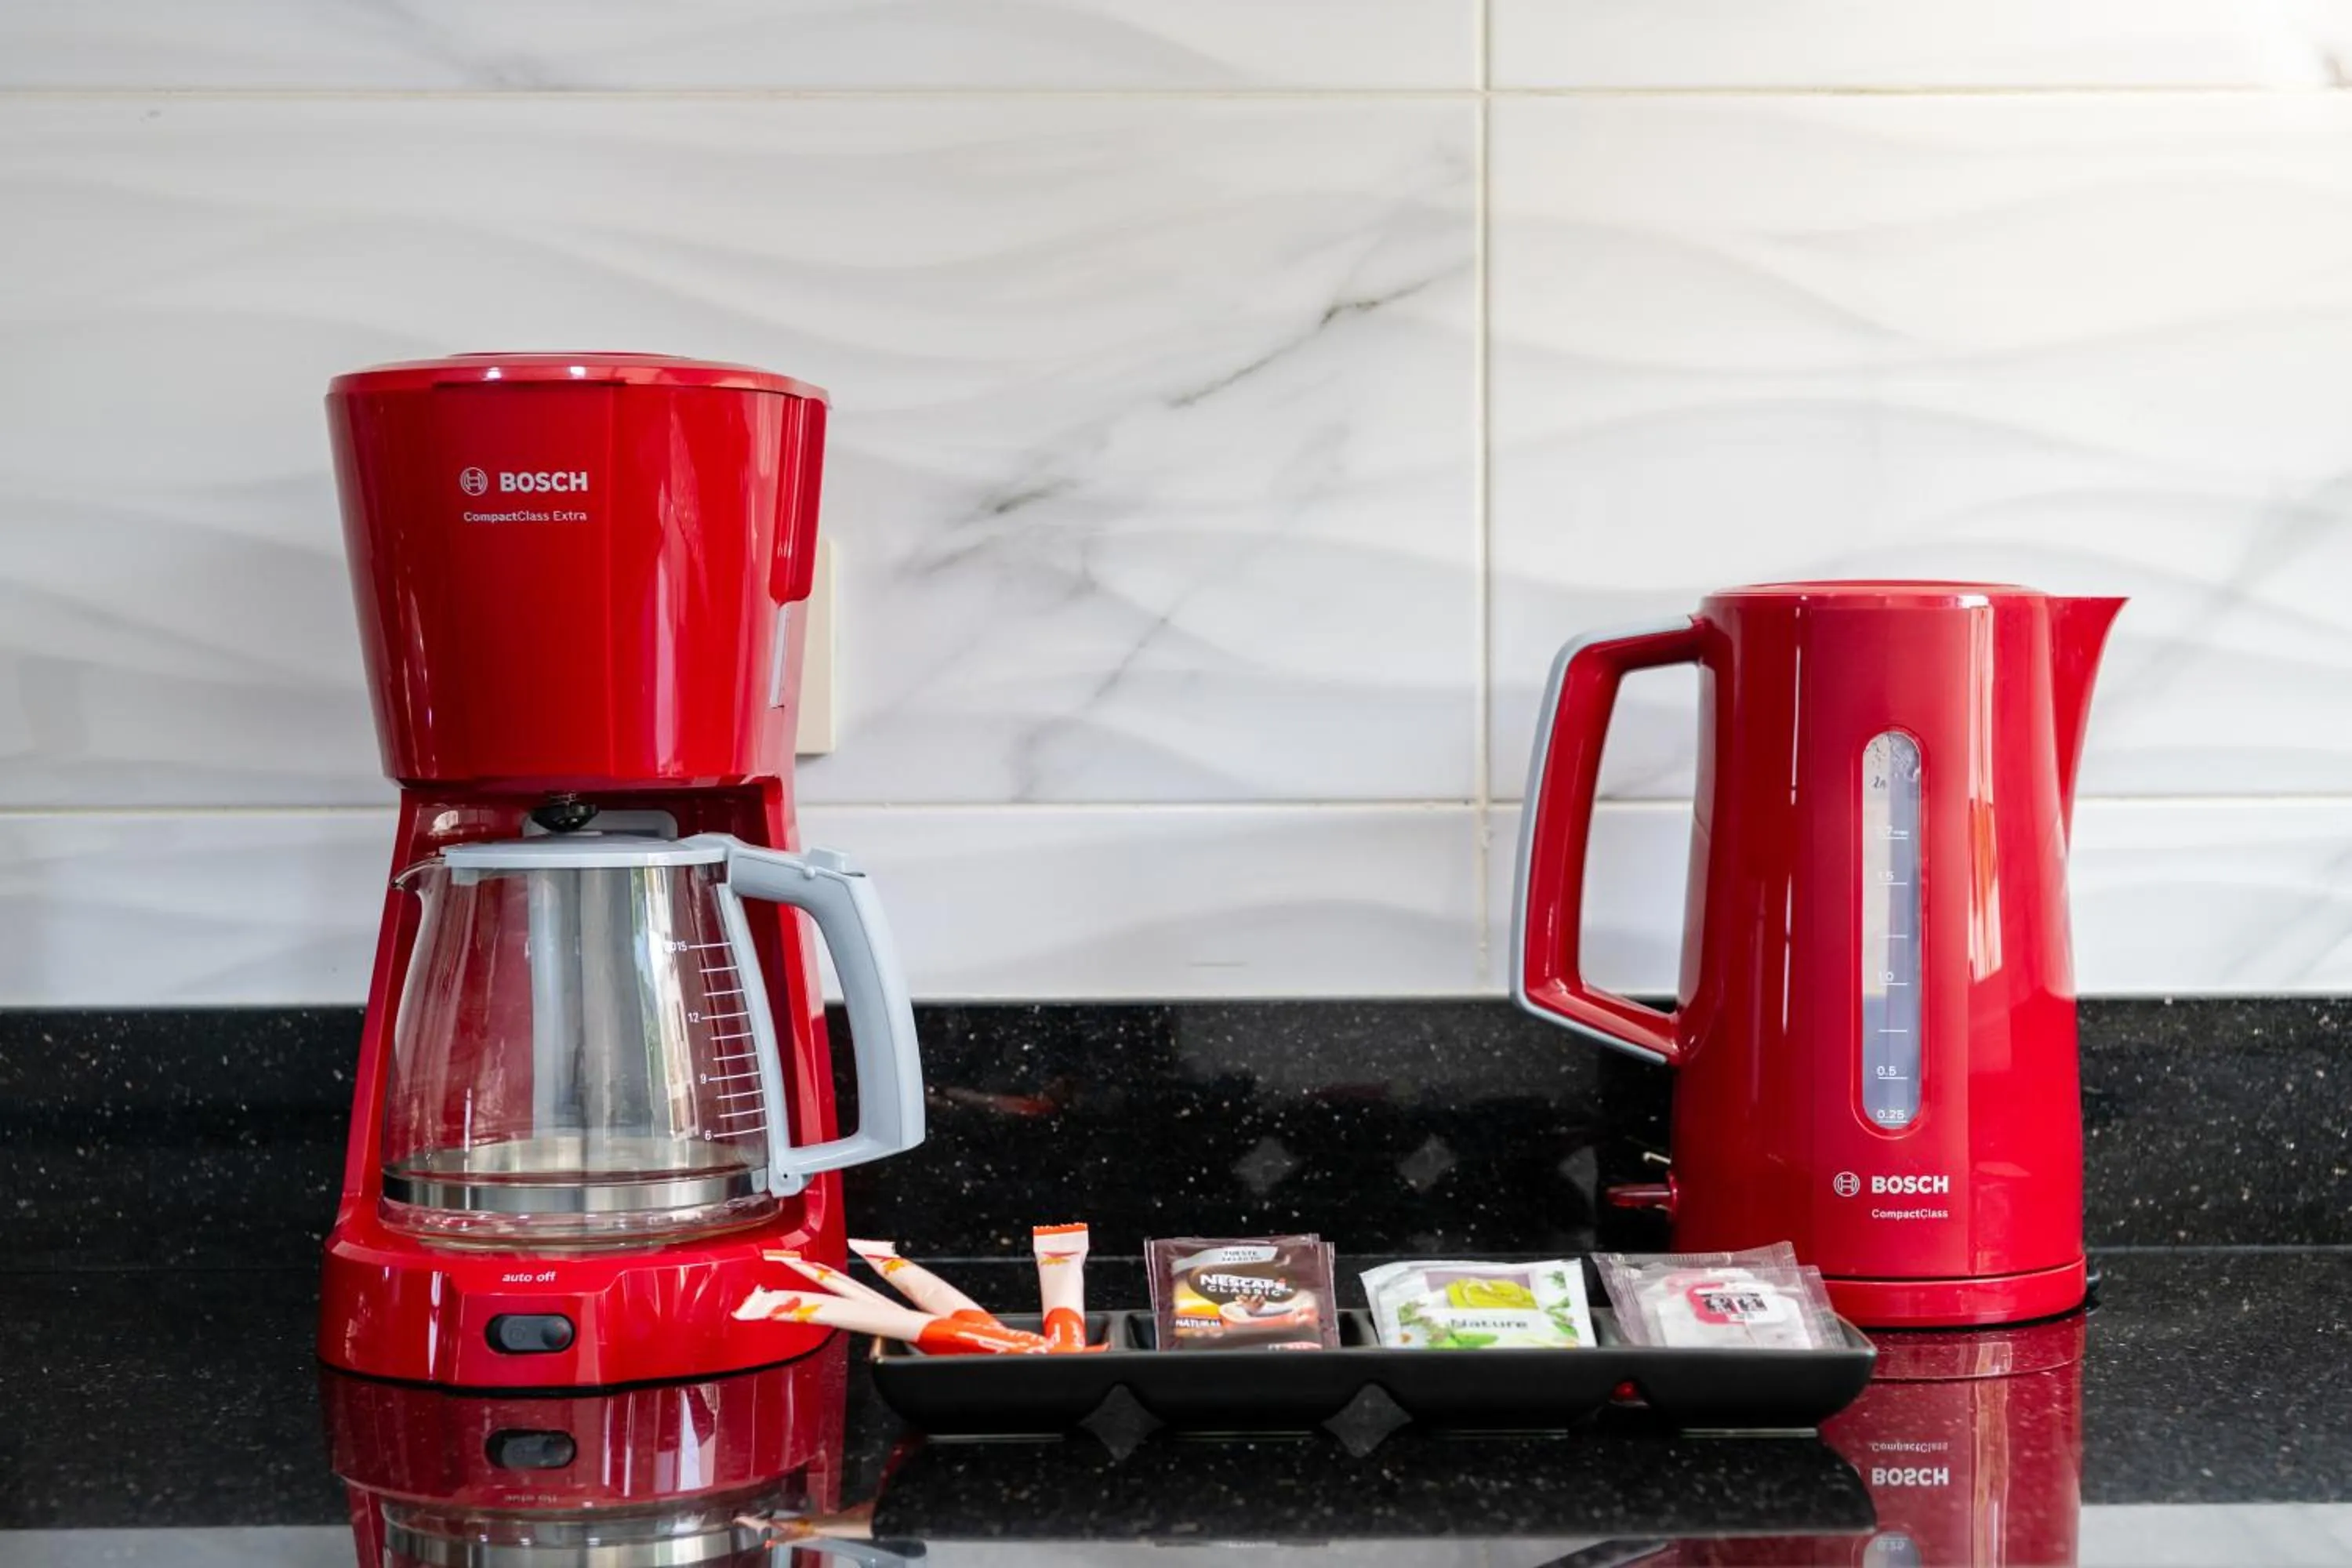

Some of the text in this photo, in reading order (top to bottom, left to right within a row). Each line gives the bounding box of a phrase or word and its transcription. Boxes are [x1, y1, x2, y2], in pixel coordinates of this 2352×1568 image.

[499, 471, 588, 492] BOSCH
[463, 510, 587, 524] CompactClass Extra
[688, 1012, 700, 1023] 12
[1876, 1065, 1897, 1076] 0.5
[700, 1073, 706, 1085] 9
[1876, 1109, 1905, 1120] 0.25
[705, 1131, 712, 1141] 6
[1871, 1175, 1949, 1194] BOSCH
[1871, 1208, 1949, 1221] CompactClass
[502, 1271, 557, 1283] auto off
